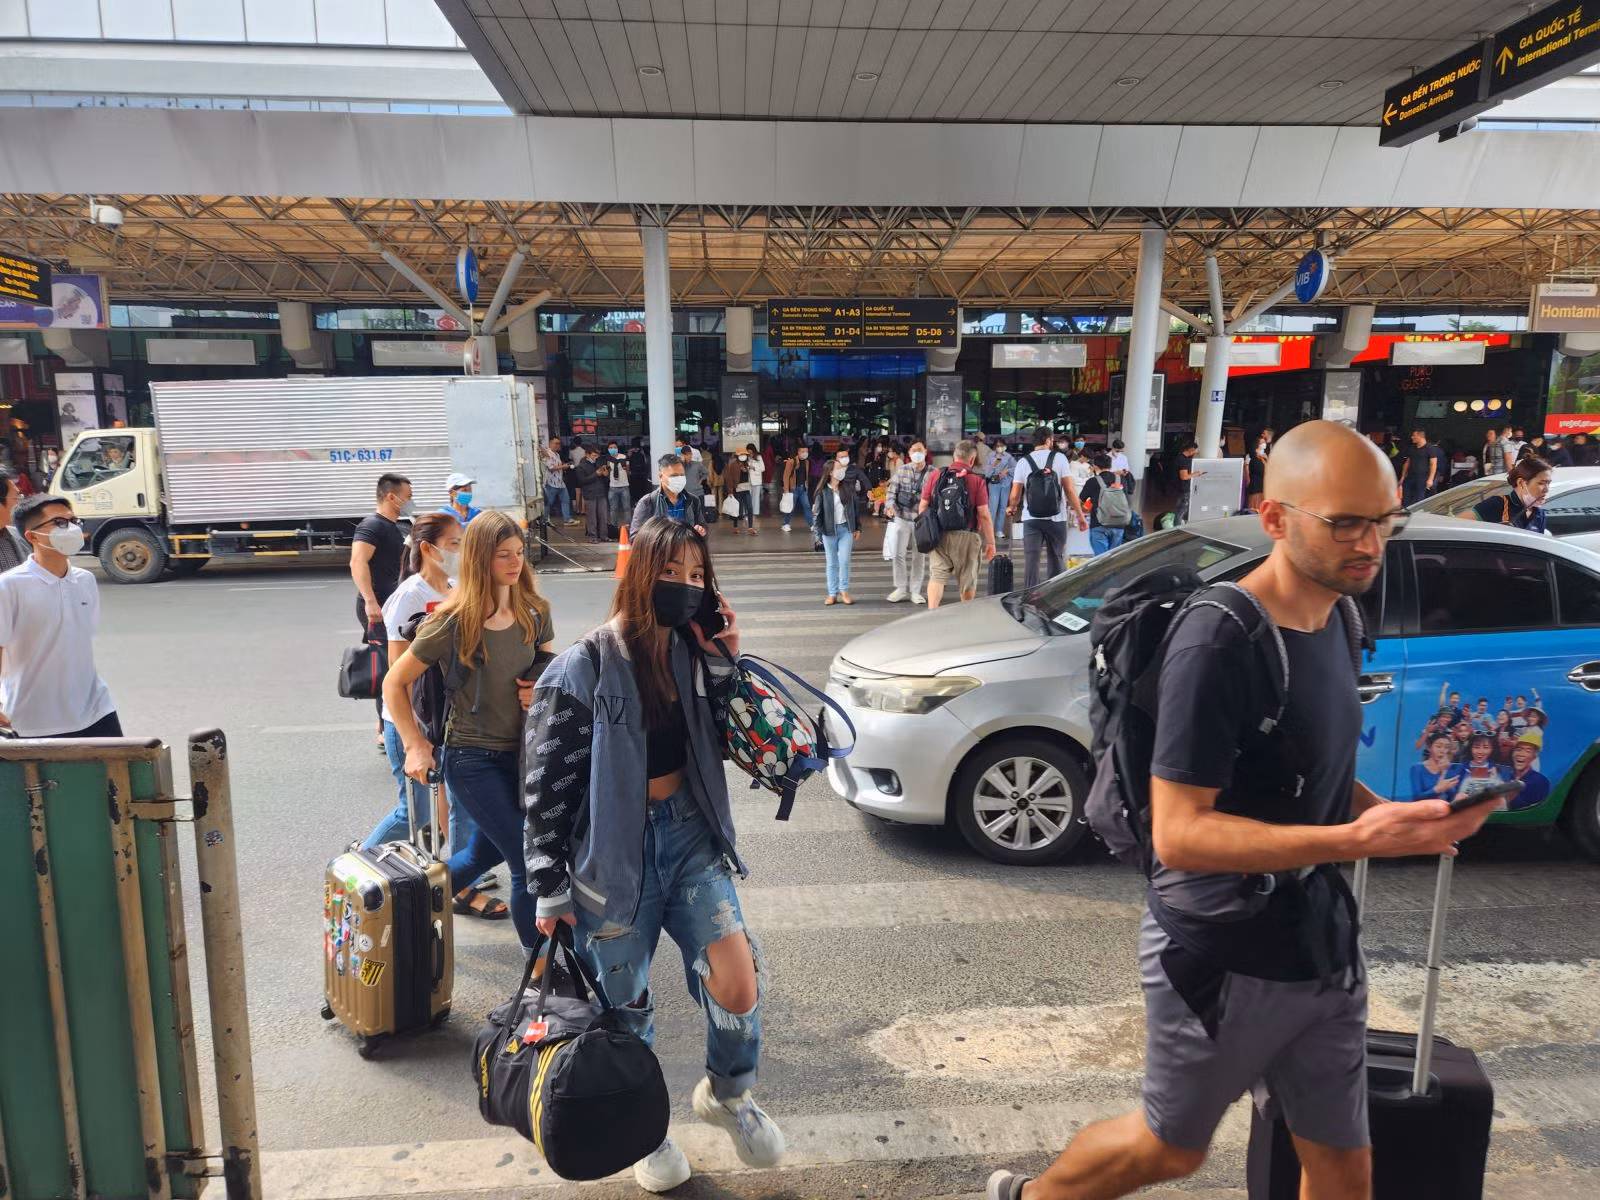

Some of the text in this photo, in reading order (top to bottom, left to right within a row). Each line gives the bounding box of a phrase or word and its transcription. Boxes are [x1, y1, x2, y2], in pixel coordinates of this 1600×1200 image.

[1519, 5, 1583, 50] GA QUỐC TẾ
[1517, 32, 1572, 67] International
[1400, 94, 1412, 106] GA
[1429, 71, 1456, 92] TRONG
[1399, 89, 1454, 120] Domestic Arrivals
[835, 309, 861, 317] A1-A3
[834, 327, 861, 336] D1-D4
[916, 328, 942, 336] D5-D8
[547, 708, 574, 726] GONZZONE
[564, 746, 591, 764] GONZZONE
[551, 772, 578, 791] GONZZONE
[540, 801, 567, 819] GONZZONE
